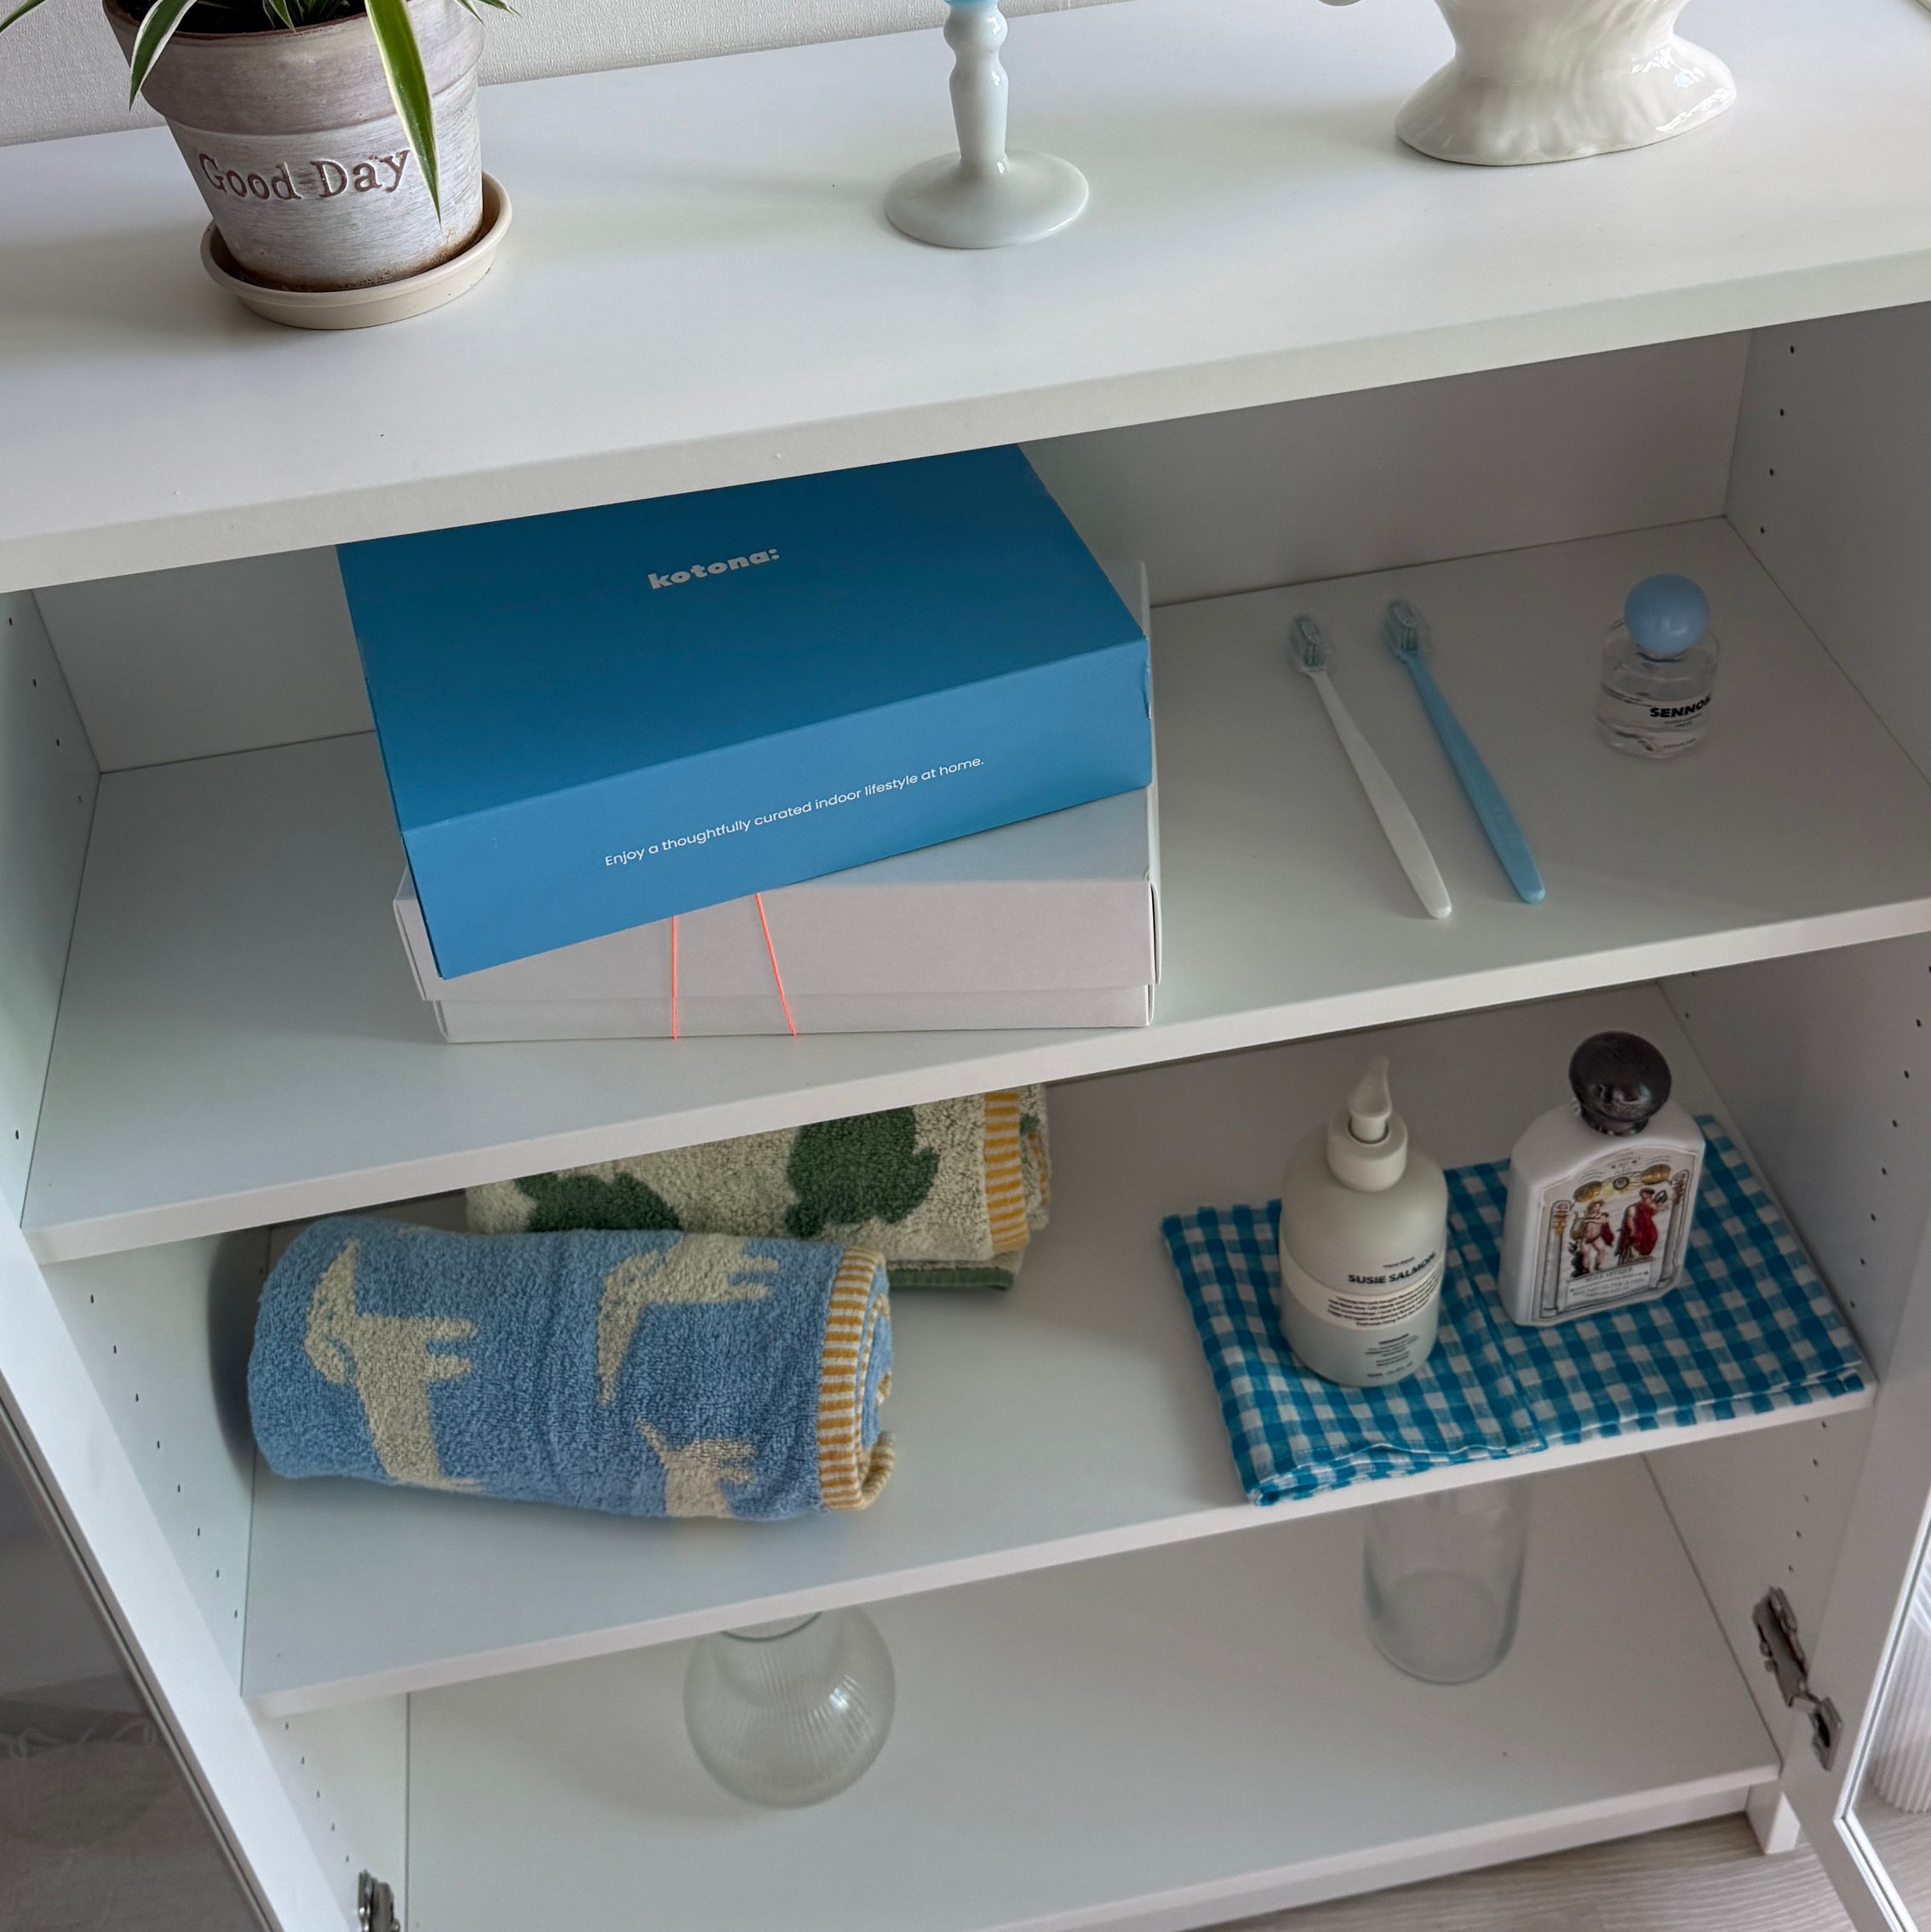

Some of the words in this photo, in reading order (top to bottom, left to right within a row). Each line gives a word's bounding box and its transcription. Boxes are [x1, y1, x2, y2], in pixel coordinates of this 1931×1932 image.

[198, 152, 302, 201] Good
[310, 149, 410, 198] Day
[647, 548, 780, 589] kotona:
[605, 848, 645, 866] Enjoy
[648, 845, 659, 855] a
[662, 819, 751, 851] thoughtfully
[754, 801, 812, 826] curated
[815, 789, 862, 810] indoor
[864, 775, 918, 796] lifestyle
[920, 769, 937, 781] at
[939, 758, 984, 776] home.
[1348, 1275, 1386, 1284] SUSIE
